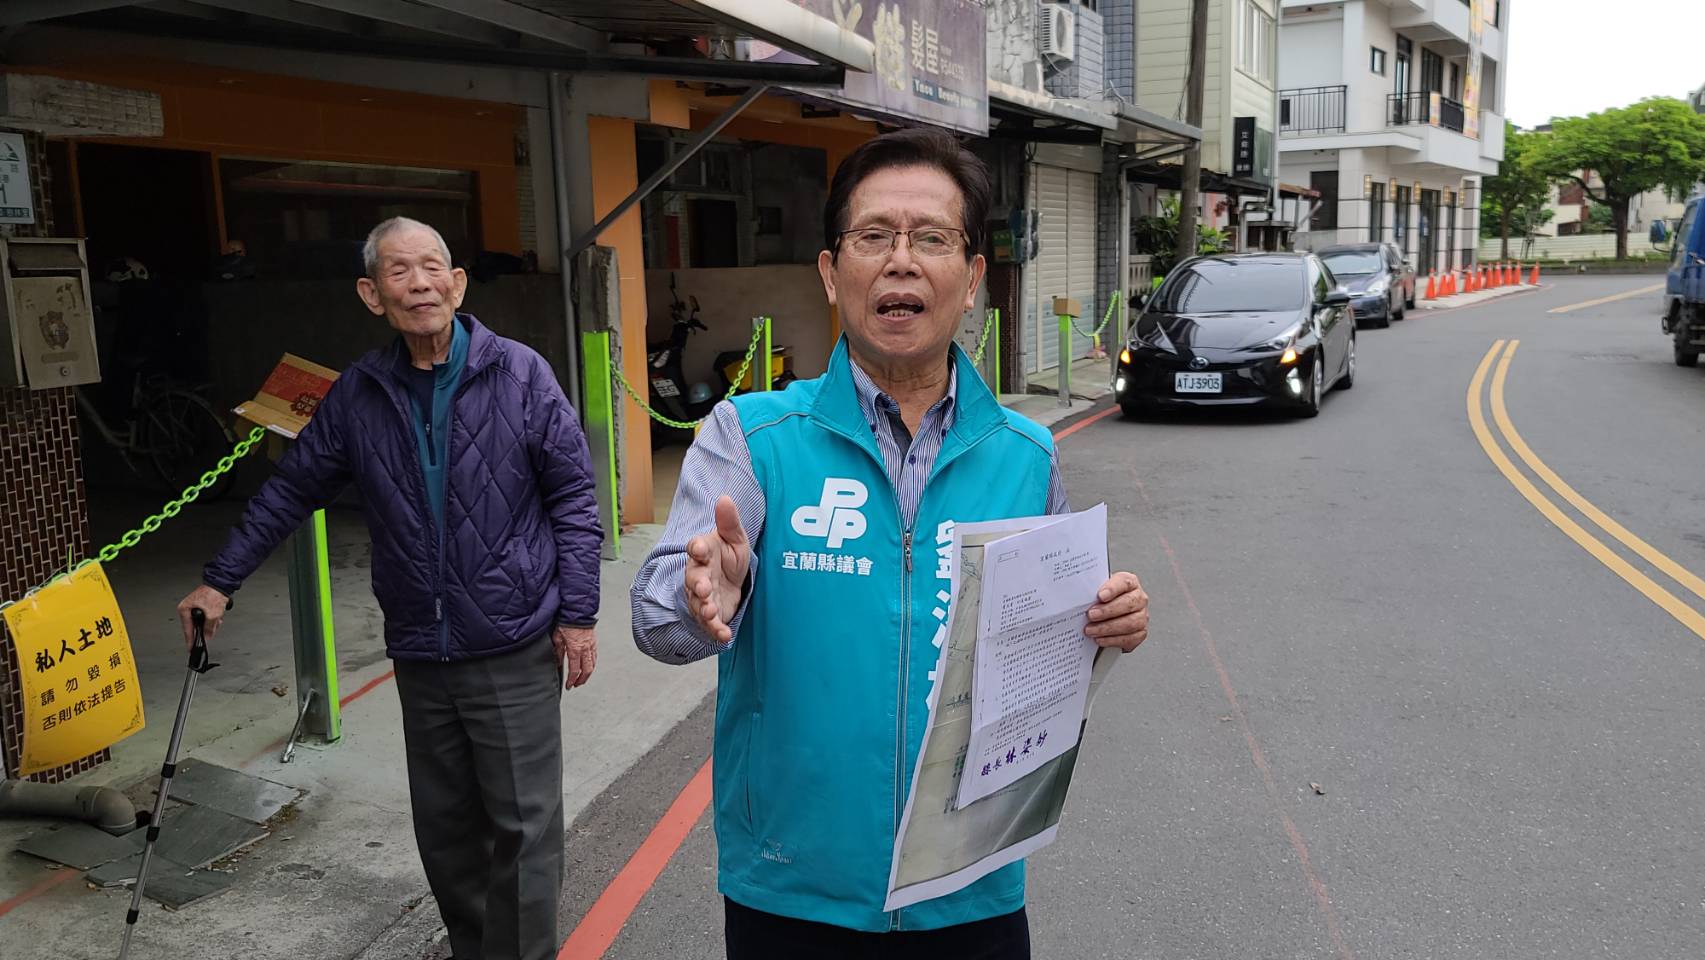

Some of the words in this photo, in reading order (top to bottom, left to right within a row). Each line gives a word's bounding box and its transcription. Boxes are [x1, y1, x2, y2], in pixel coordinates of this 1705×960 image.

[781, 550, 875, 576] 宜蘭縣議會
[35, 616, 114, 674] 私人土地
[40, 652, 122, 707] 請勿毀損
[42, 678, 127, 731] 否則依法提告
